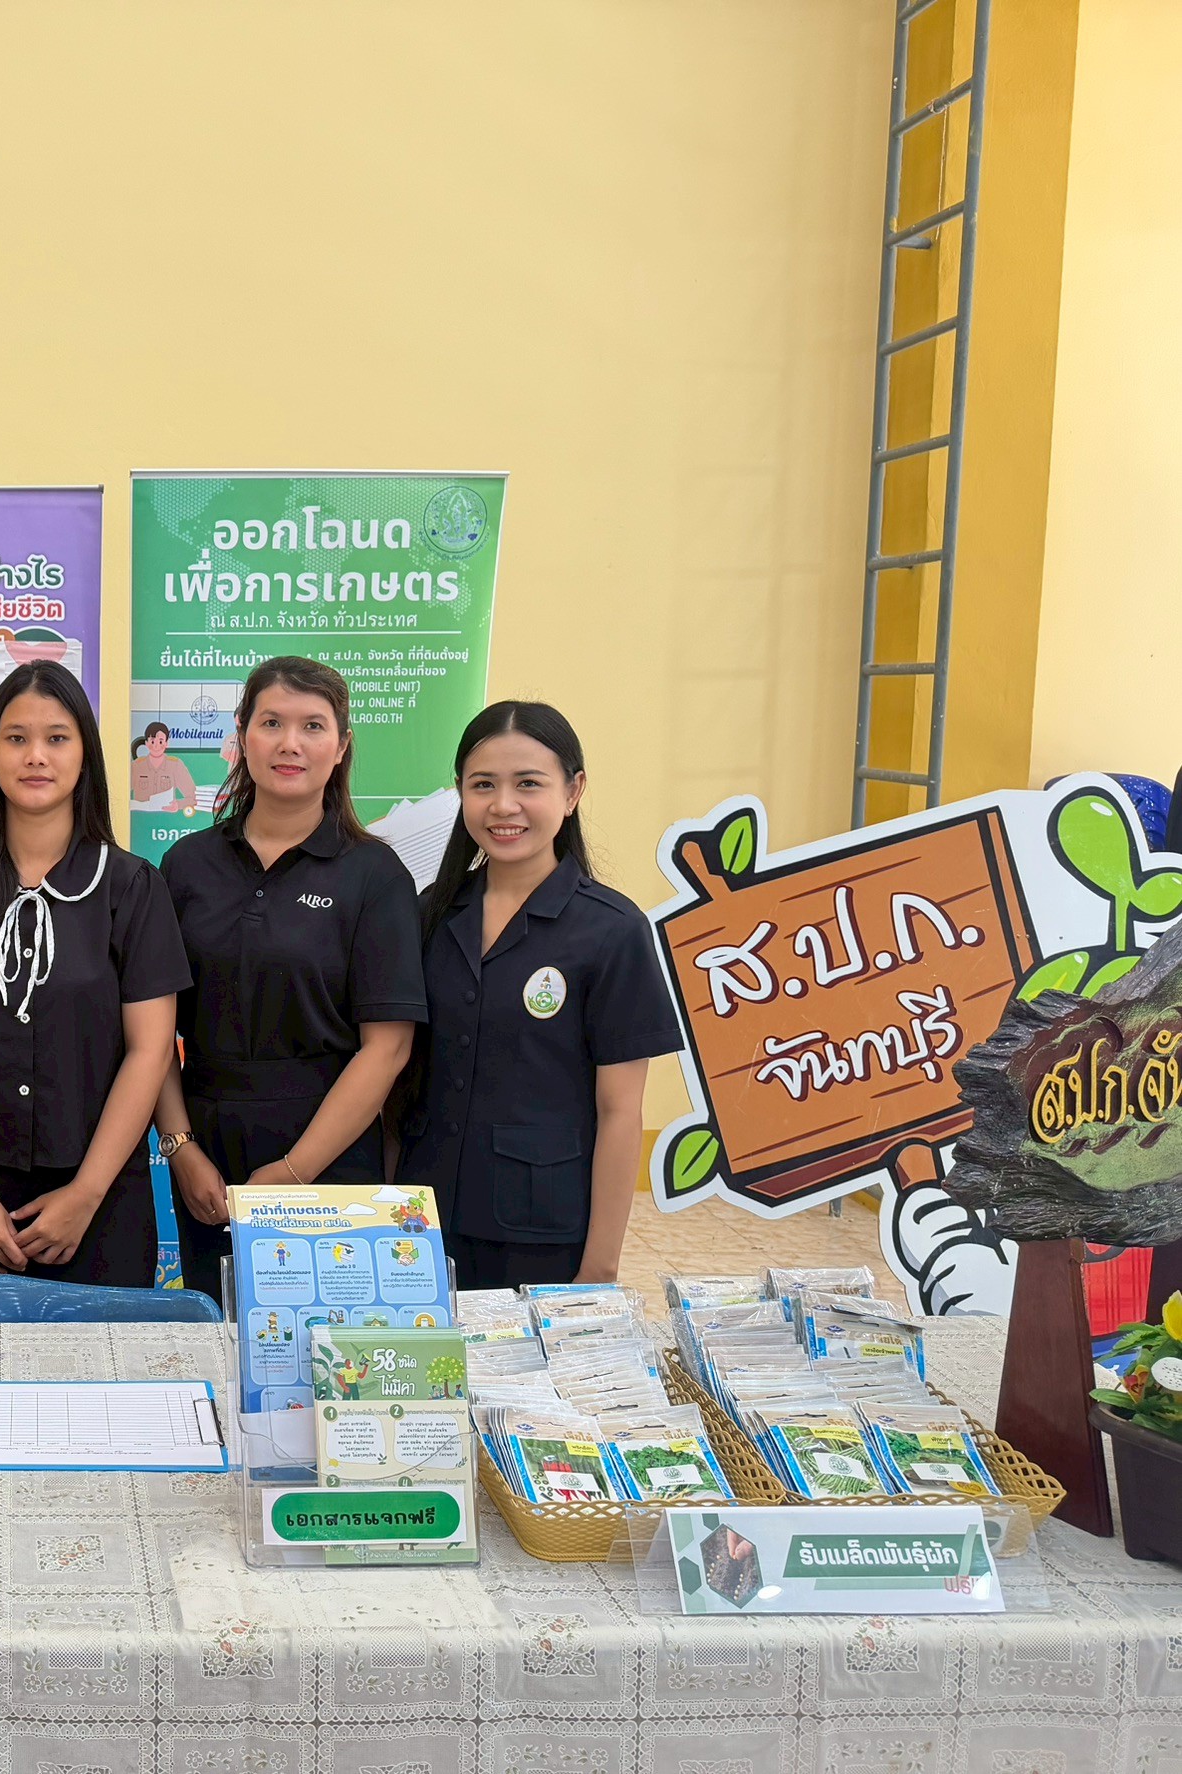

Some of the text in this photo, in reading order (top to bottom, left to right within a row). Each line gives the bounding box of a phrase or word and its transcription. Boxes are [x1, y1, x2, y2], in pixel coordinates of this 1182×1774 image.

[213, 506, 411, 549] ออกโฉนด
[164, 549, 460, 602] เพื่อการเกษตร
[211, 604, 418, 629] ณ ส.ป.ก. จังหวัด ทั่วประเทศ
[160, 645, 274, 667] ยื่นได้ที่ไหนบ้า
[318, 644, 469, 664] ณ ส.ป.ก. จังหวัด ที่ที่ดินตั้งอยู่
[330, 661, 447, 677] ยบริการเคลื่อนที่ของ
[350, 680, 421, 693] (MOBILE UNIT)
[368, 697, 405, 708] ONLINE
[296, 893, 334, 909] ALRO
[695, 886, 982, 1017] ส.ป.ก.
[756, 985, 960, 1100] จันทบุรี
[250, 1202, 339, 1216] หน้าที่เกษตรกร
[371, 1347, 397, 1372] 58
[285, 1506, 436, 1527] เอกสารแจกฟรี
[799, 1539, 959, 1572] รับเมล็ดพันธุ์ผัก
